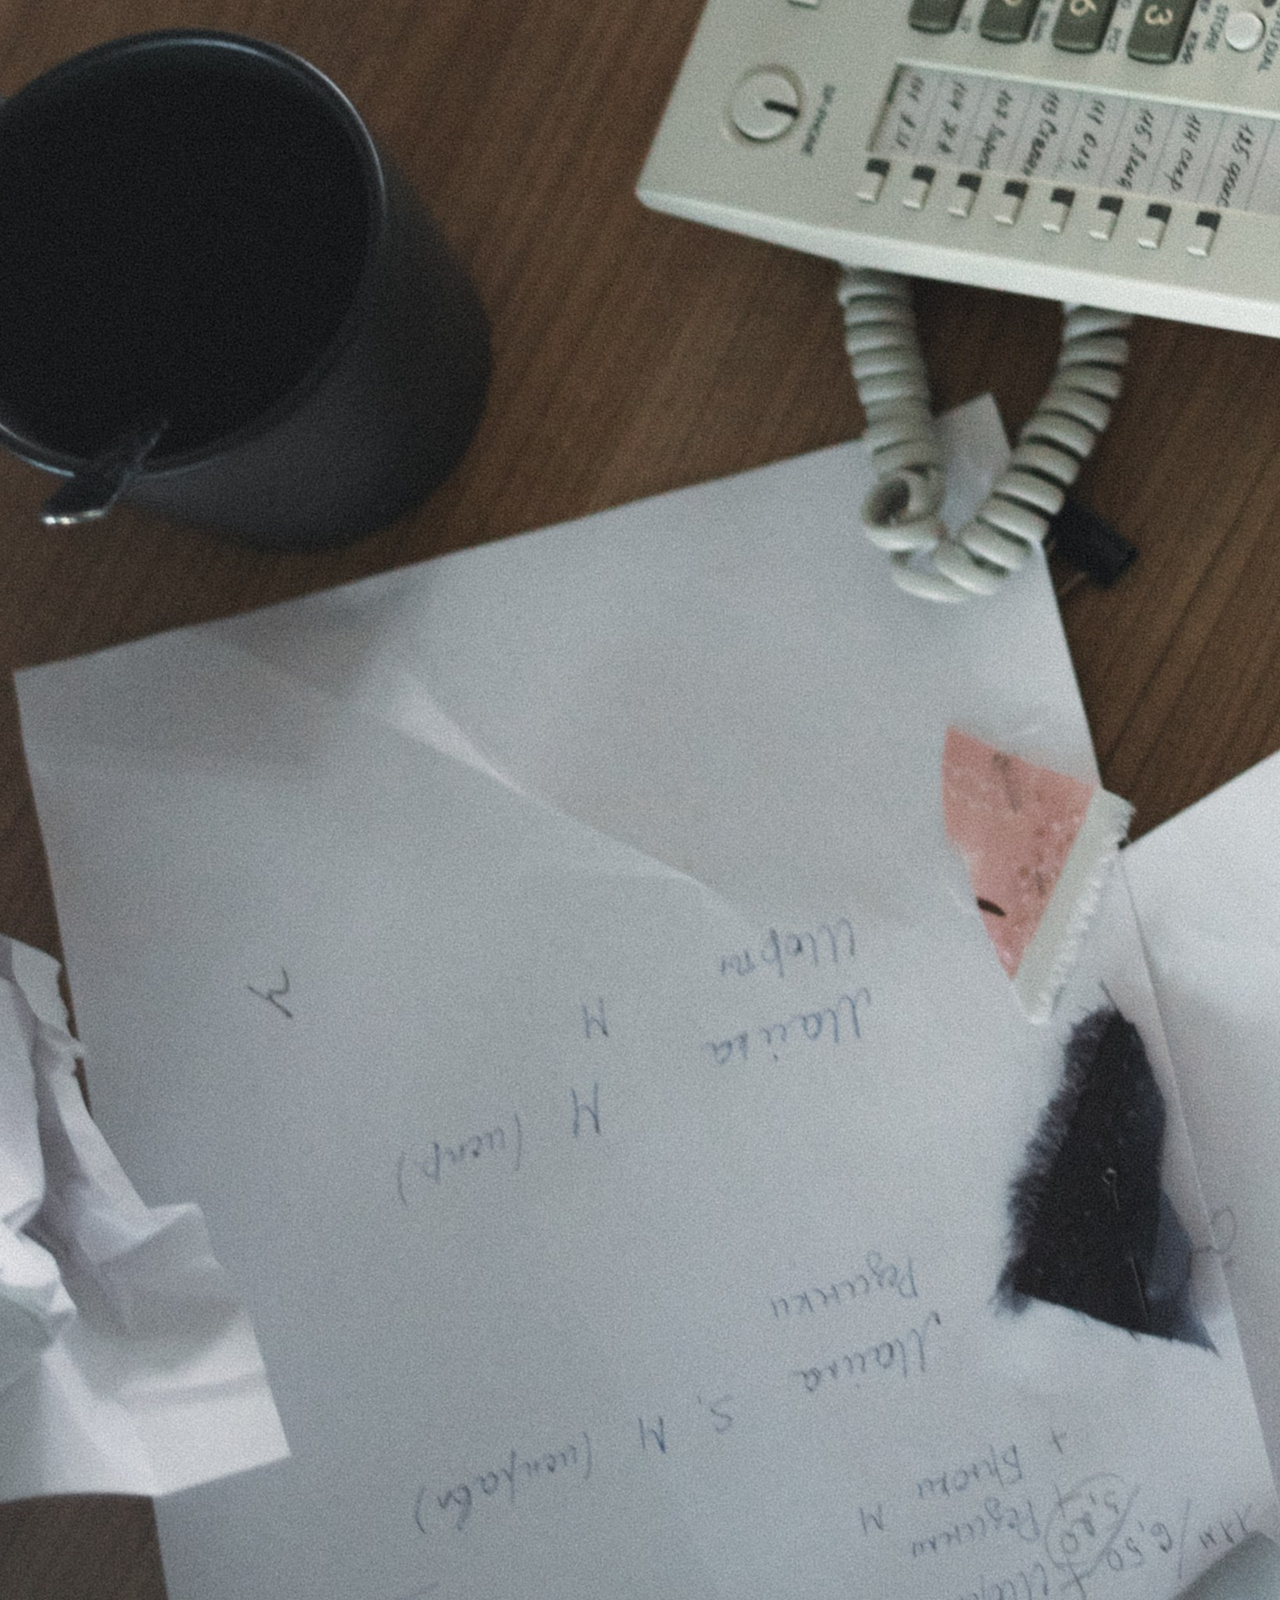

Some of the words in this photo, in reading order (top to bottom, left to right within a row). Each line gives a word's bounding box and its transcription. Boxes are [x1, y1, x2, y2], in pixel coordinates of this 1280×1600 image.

[1141, 2, 1175, 31] 3
[1202, 2, 1229, 53] STORE
[1256, 39, 1279, 75] DIAL
[1229, 123, 1257, 159] 125
[705, 987, 872, 1065] Майка
[772, 1248, 920, 1318] Резинки
[793, 1311, 941, 1392] Майка
[918, 1444, 1023, 1498] Брюки
